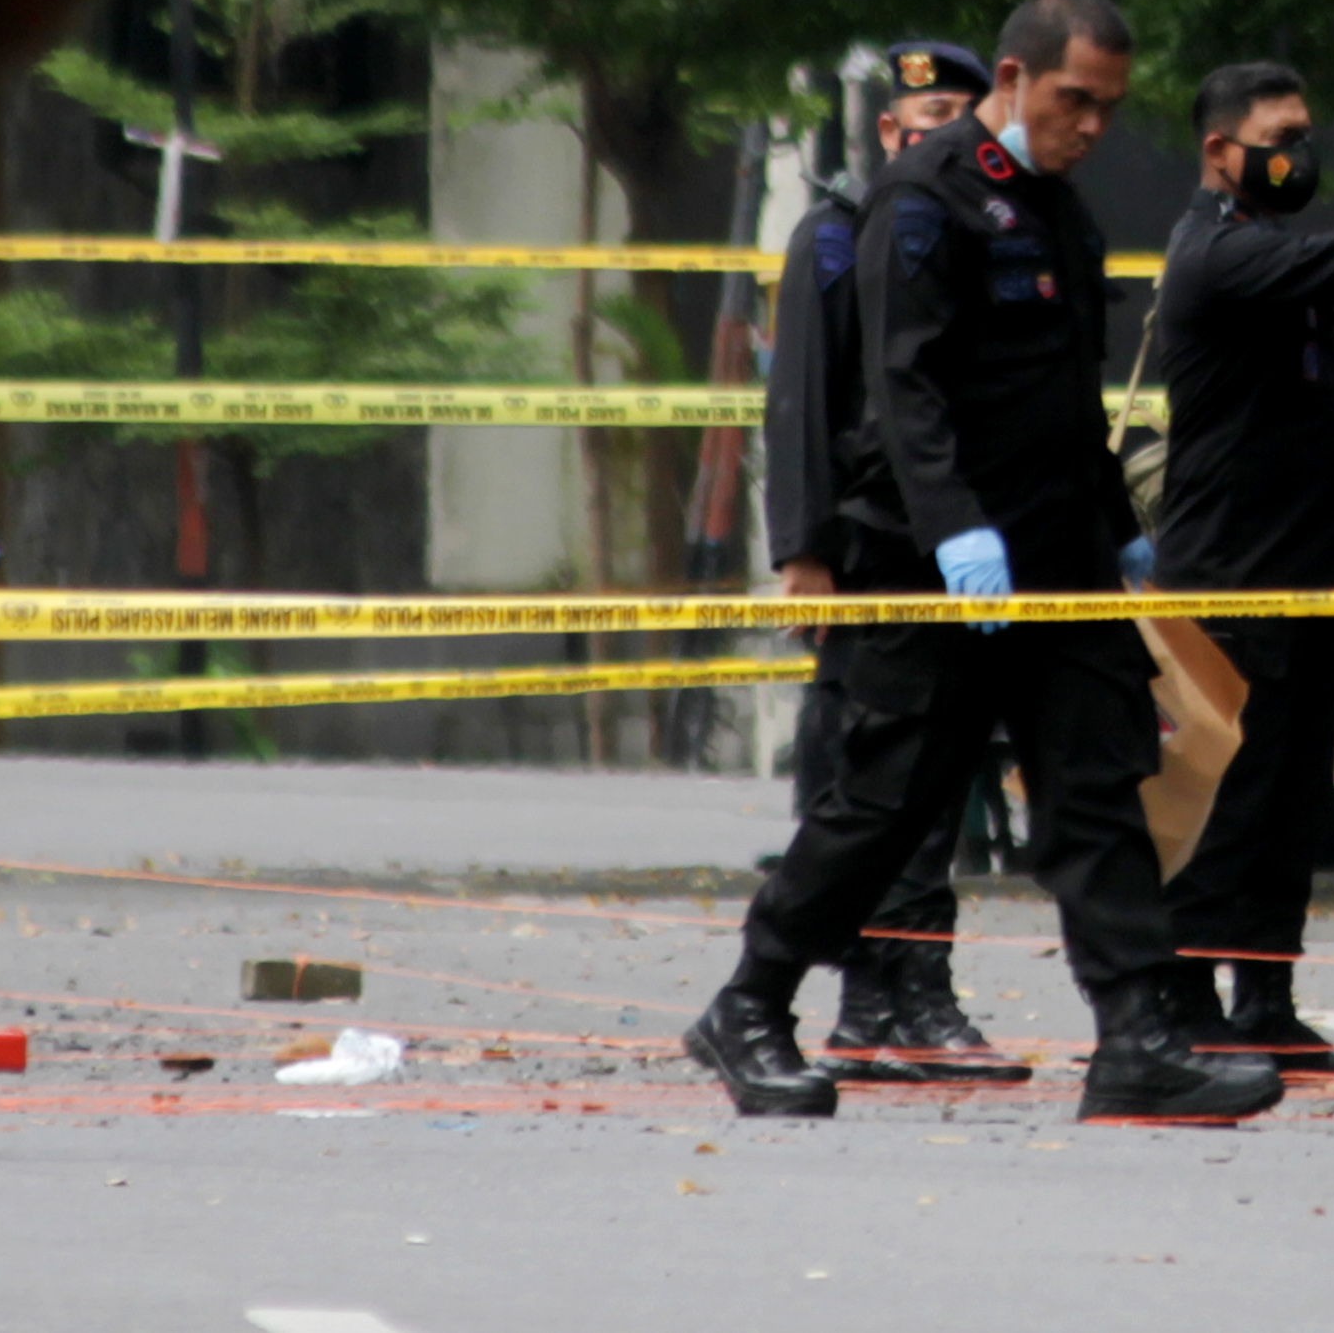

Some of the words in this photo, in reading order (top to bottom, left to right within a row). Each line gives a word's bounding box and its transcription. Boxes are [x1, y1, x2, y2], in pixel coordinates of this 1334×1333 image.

[51, 607, 99, 632] POLISI
[240, 608, 317, 630] DILARANG
[373, 606, 422, 630] POLISI
[560, 605, 638, 627] DILARANG
[696, 604, 745, 627] POLISI
[883, 602, 961, 624] DILARANG
